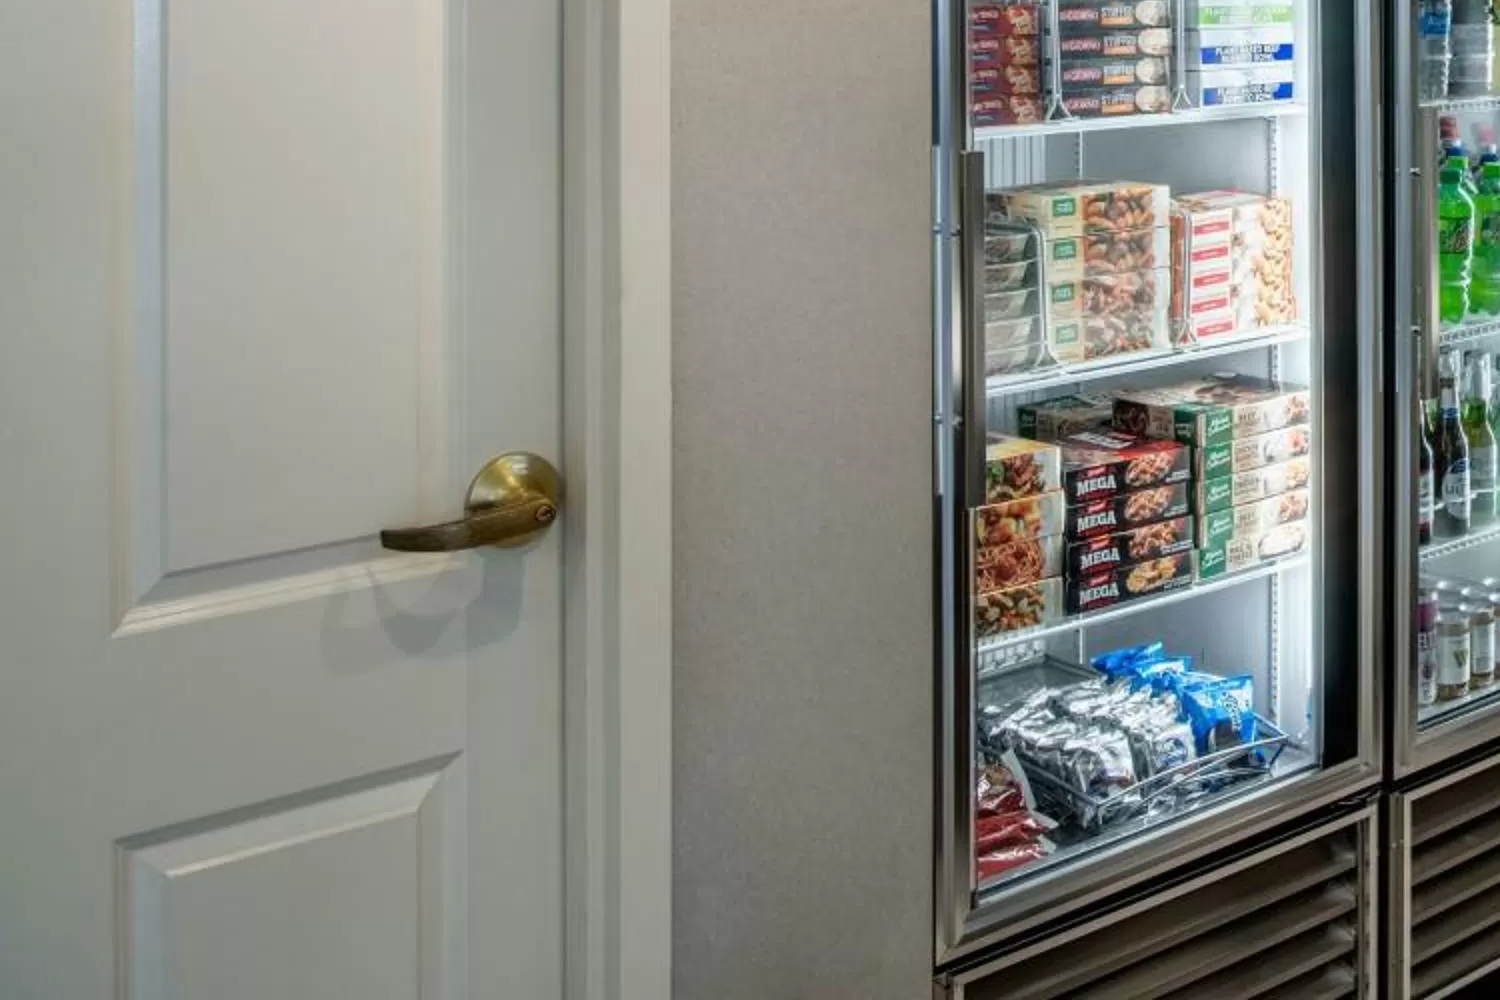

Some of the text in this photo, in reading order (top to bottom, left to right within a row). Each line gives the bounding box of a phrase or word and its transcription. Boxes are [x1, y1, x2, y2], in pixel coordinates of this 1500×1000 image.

[1076, 474, 1117, 497] MEGA
[1077, 510, 1117, 532] MEGA
[1080, 547, 1121, 570] MEGA
[1079, 582, 1120, 605] MEGA
